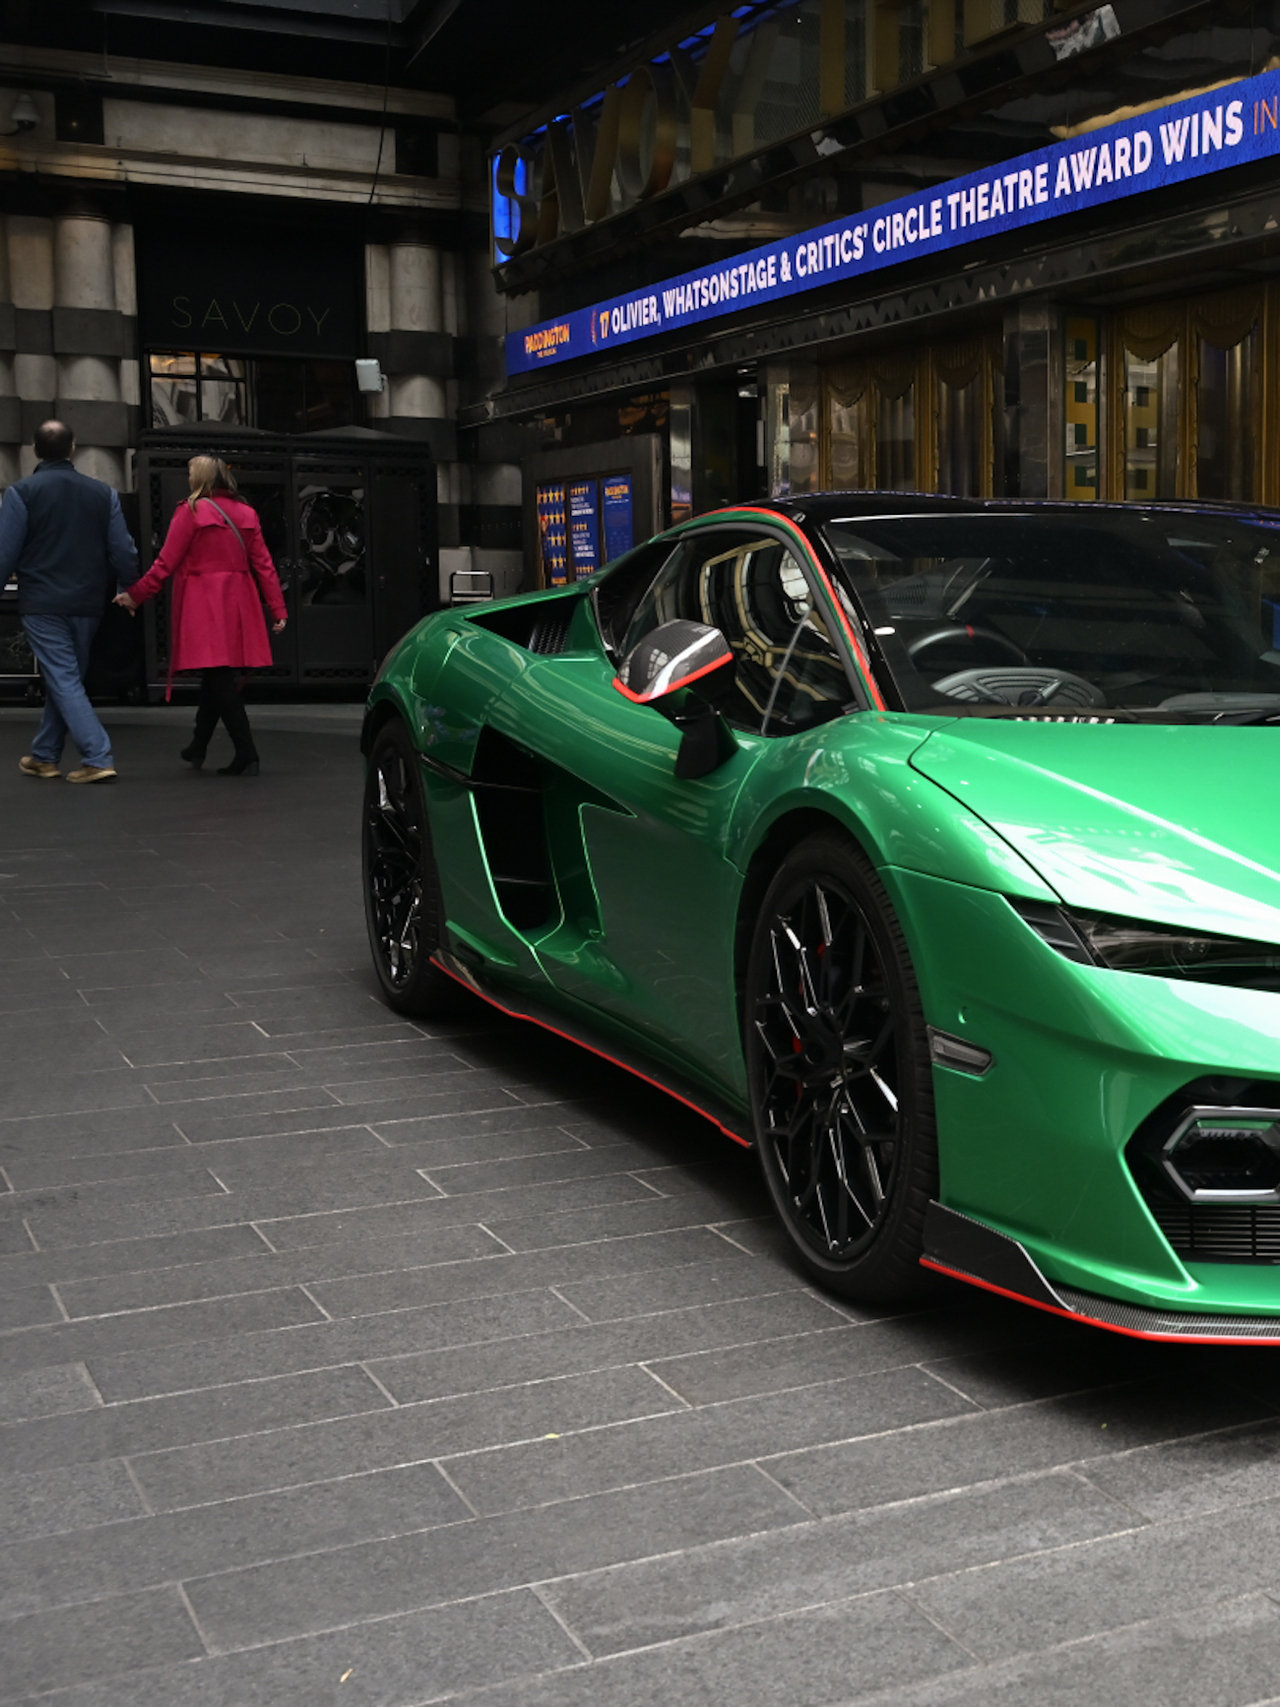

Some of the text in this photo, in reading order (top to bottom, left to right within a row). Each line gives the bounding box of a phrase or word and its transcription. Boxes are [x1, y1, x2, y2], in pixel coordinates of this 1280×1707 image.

[600, 310, 611, 339] 17
[611, 295, 661, 335] OLIVIER,
[662, 255, 777, 318] WHATSONSTAGE
[780, 252, 793, 282] &
[795, 224, 869, 278] CRITICS'
[872, 198, 943, 254] CIRCLE
[947, 162, 1050, 231] THEATRE
[1054, 130, 1153, 199] AWARD
[1159, 100, 1245, 165] WINS
[171, 295, 331, 337] SAVOY
